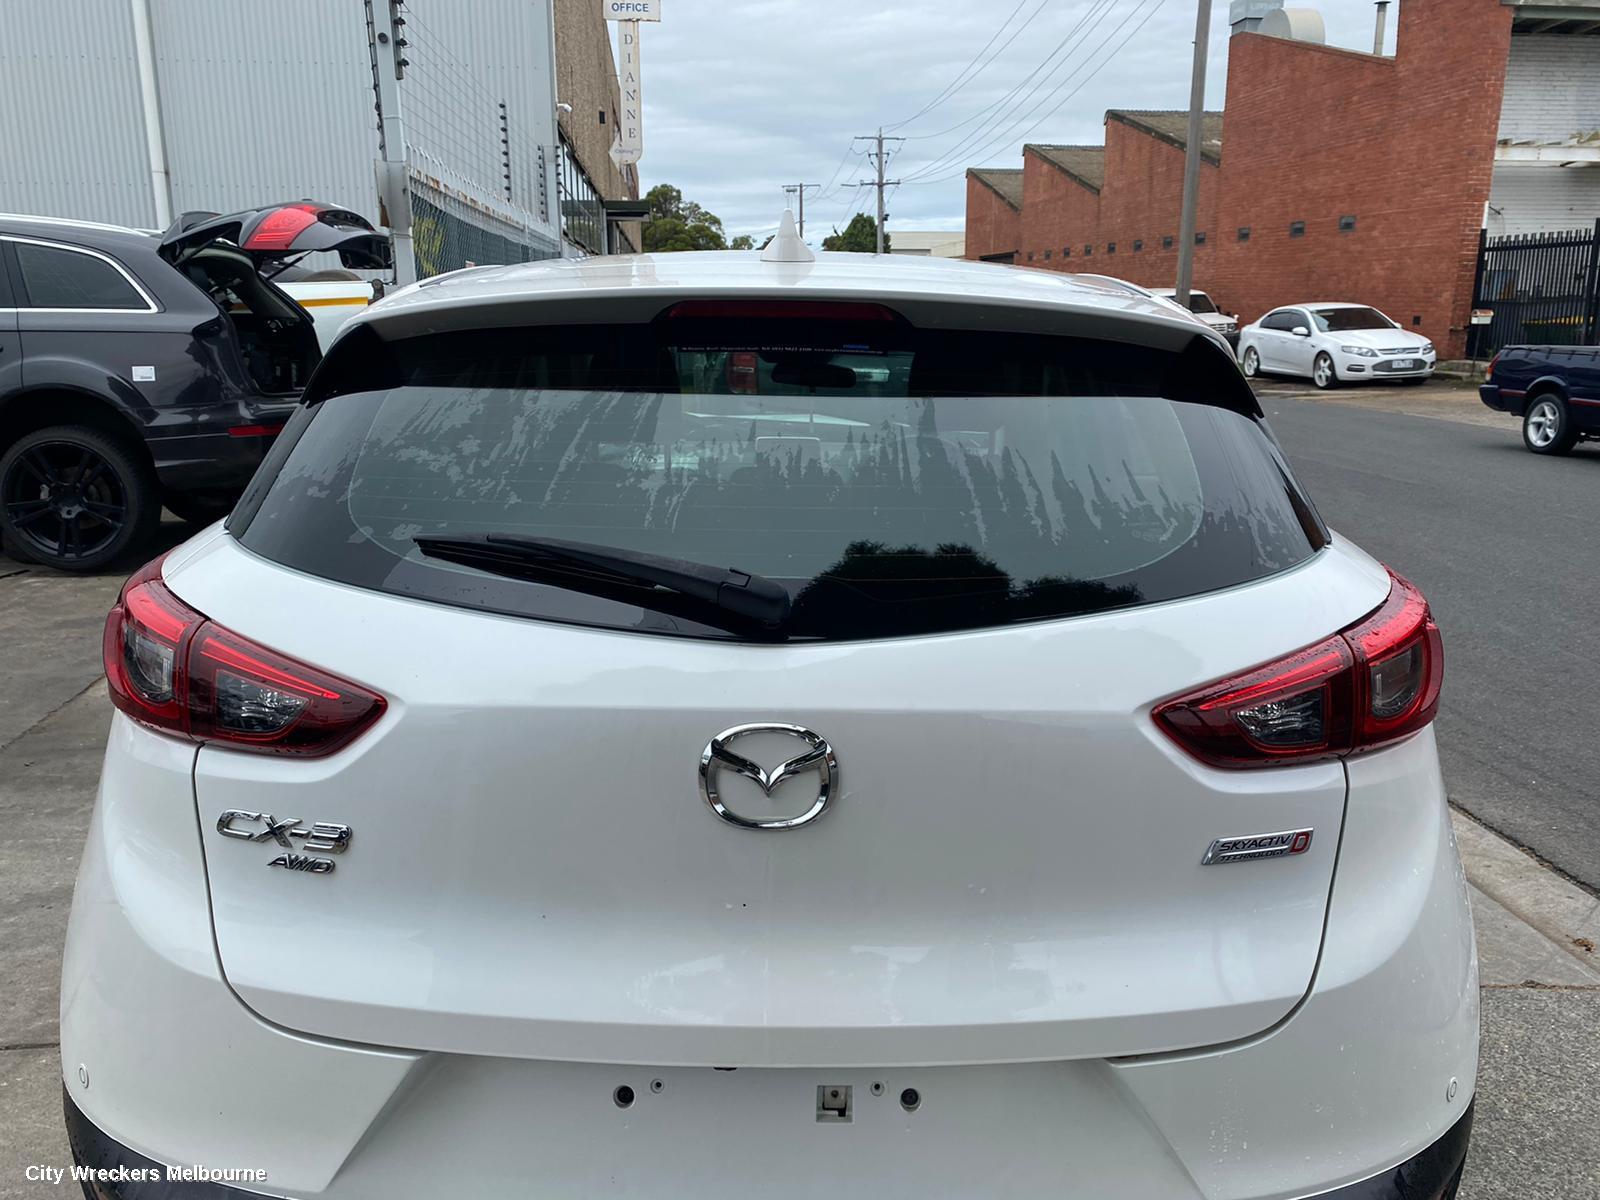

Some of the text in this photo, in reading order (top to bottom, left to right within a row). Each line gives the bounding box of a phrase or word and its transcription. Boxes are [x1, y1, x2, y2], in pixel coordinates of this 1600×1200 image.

[611, 2, 649, 12] OFFICE
[624, 34, 637, 139] DIANNE
[216, 808, 353, 855] CX-3
[1220, 831, 1310, 853] SKYACTIV D
[267, 853, 336, 874] AWD
[1220, 849, 1285, 862] TECHNOLOGY
